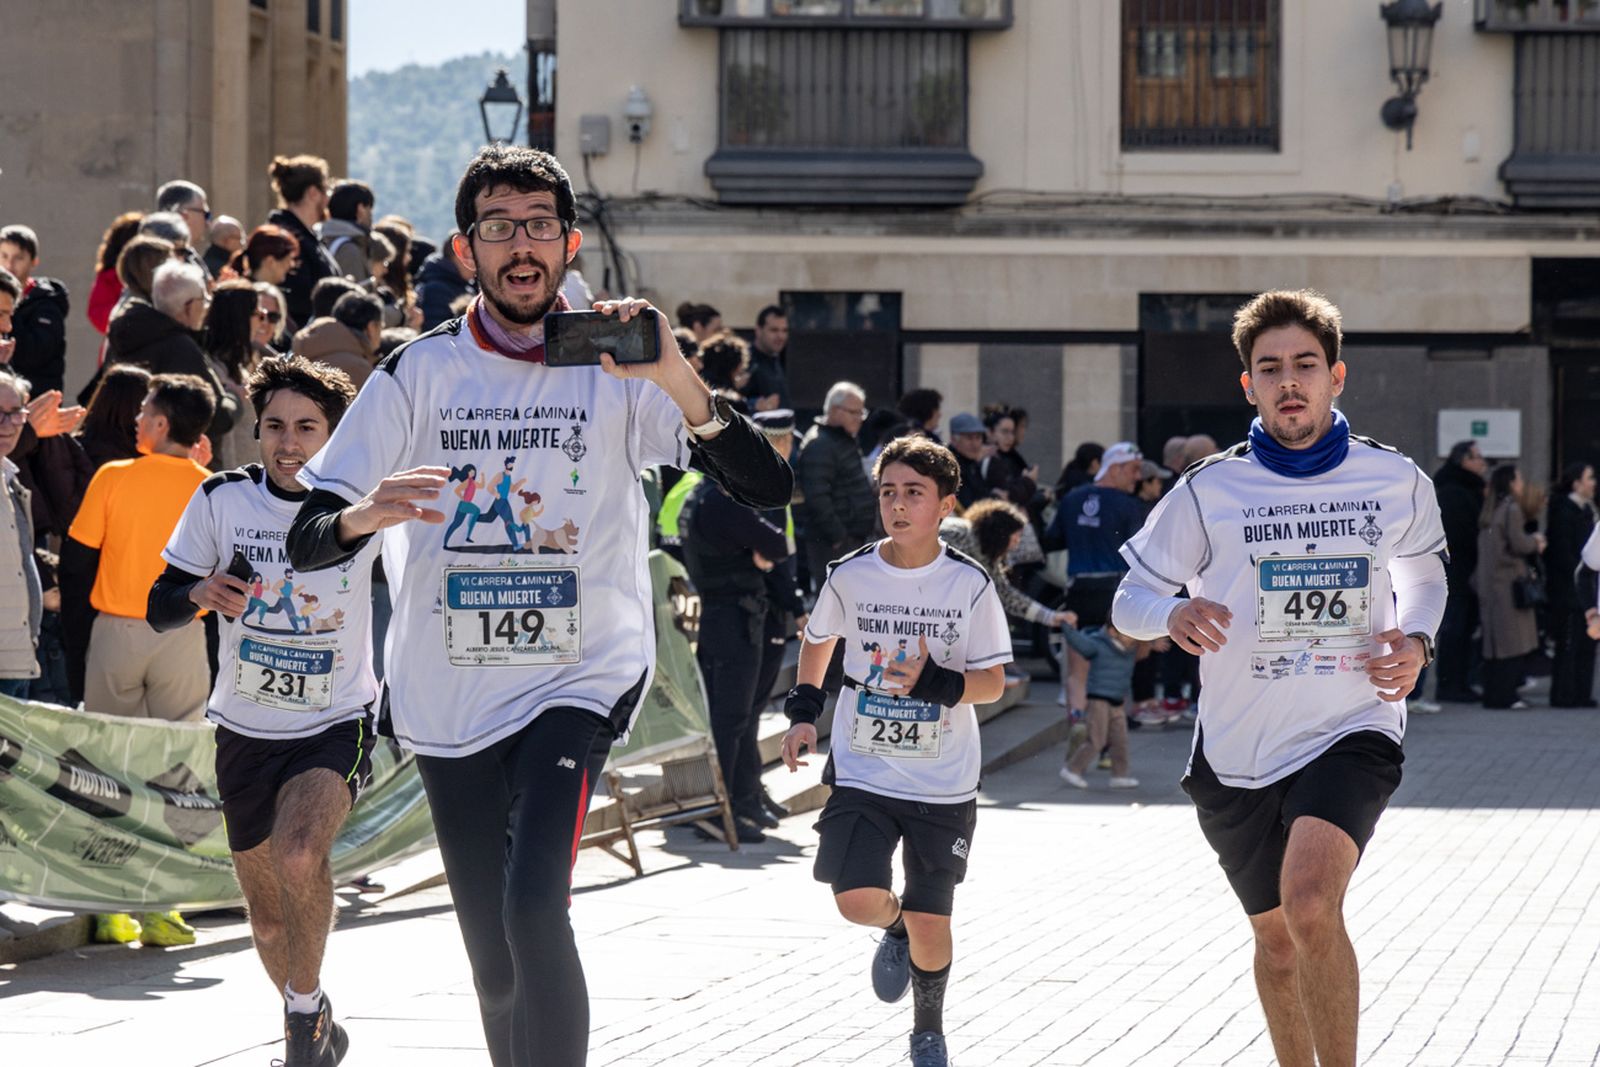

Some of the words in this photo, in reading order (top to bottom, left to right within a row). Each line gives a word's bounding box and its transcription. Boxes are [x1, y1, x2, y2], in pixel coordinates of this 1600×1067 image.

[440, 408, 452, 421] VI
[456, 406, 520, 421] CARRERA
[524, 406, 587, 422] CAMINAA
[440, 429, 491, 450] BUENA
[498, 428, 560, 450] MUERTE
[1242, 508, 1254, 518] VI
[1258, 503, 1316, 517] CARRERA
[1319, 500, 1382, 513] CAMINATA
[235, 527, 245, 537] VI
[247, 528, 288, 541] CARRER
[1244, 523, 1293, 543] BUENA
[1297, 518, 1356, 539] MUERTE
[1272, 563, 1280, 571] VI
[1281, 562, 1317, 571] CARRERA
[1319, 561, 1357, 570] CAMINATA
[460, 577, 470, 586] VI
[471, 576, 512, 586] CARRERA
[515, 575, 563, 585] CAMINATA
[1272, 575, 1302, 587] BUENA
[1305, 573, 1341, 587] MUERTE
[460, 590, 495, 605] BUENA
[498, 590, 541, 605] MUERTE
[1284, 590, 1347, 620] 496
[866, 603, 910, 615] CARRERA
[913, 607, 962, 618] CAMINATA
[478, 609, 545, 645] 149
[857, 617, 889, 634] BUENA
[893, 620, 940, 638] MUERTE
[257, 644, 288, 656] CARRERA
[289, 650, 324, 660] CAMINATA
[249, 652, 273, 666] BUENA
[275, 657, 308, 672] MUERTE
[259, 668, 306, 698] 231
[865, 703, 886, 716] BUENA
[888, 708, 917, 720] MUERTE
[871, 719, 920, 745] 234
